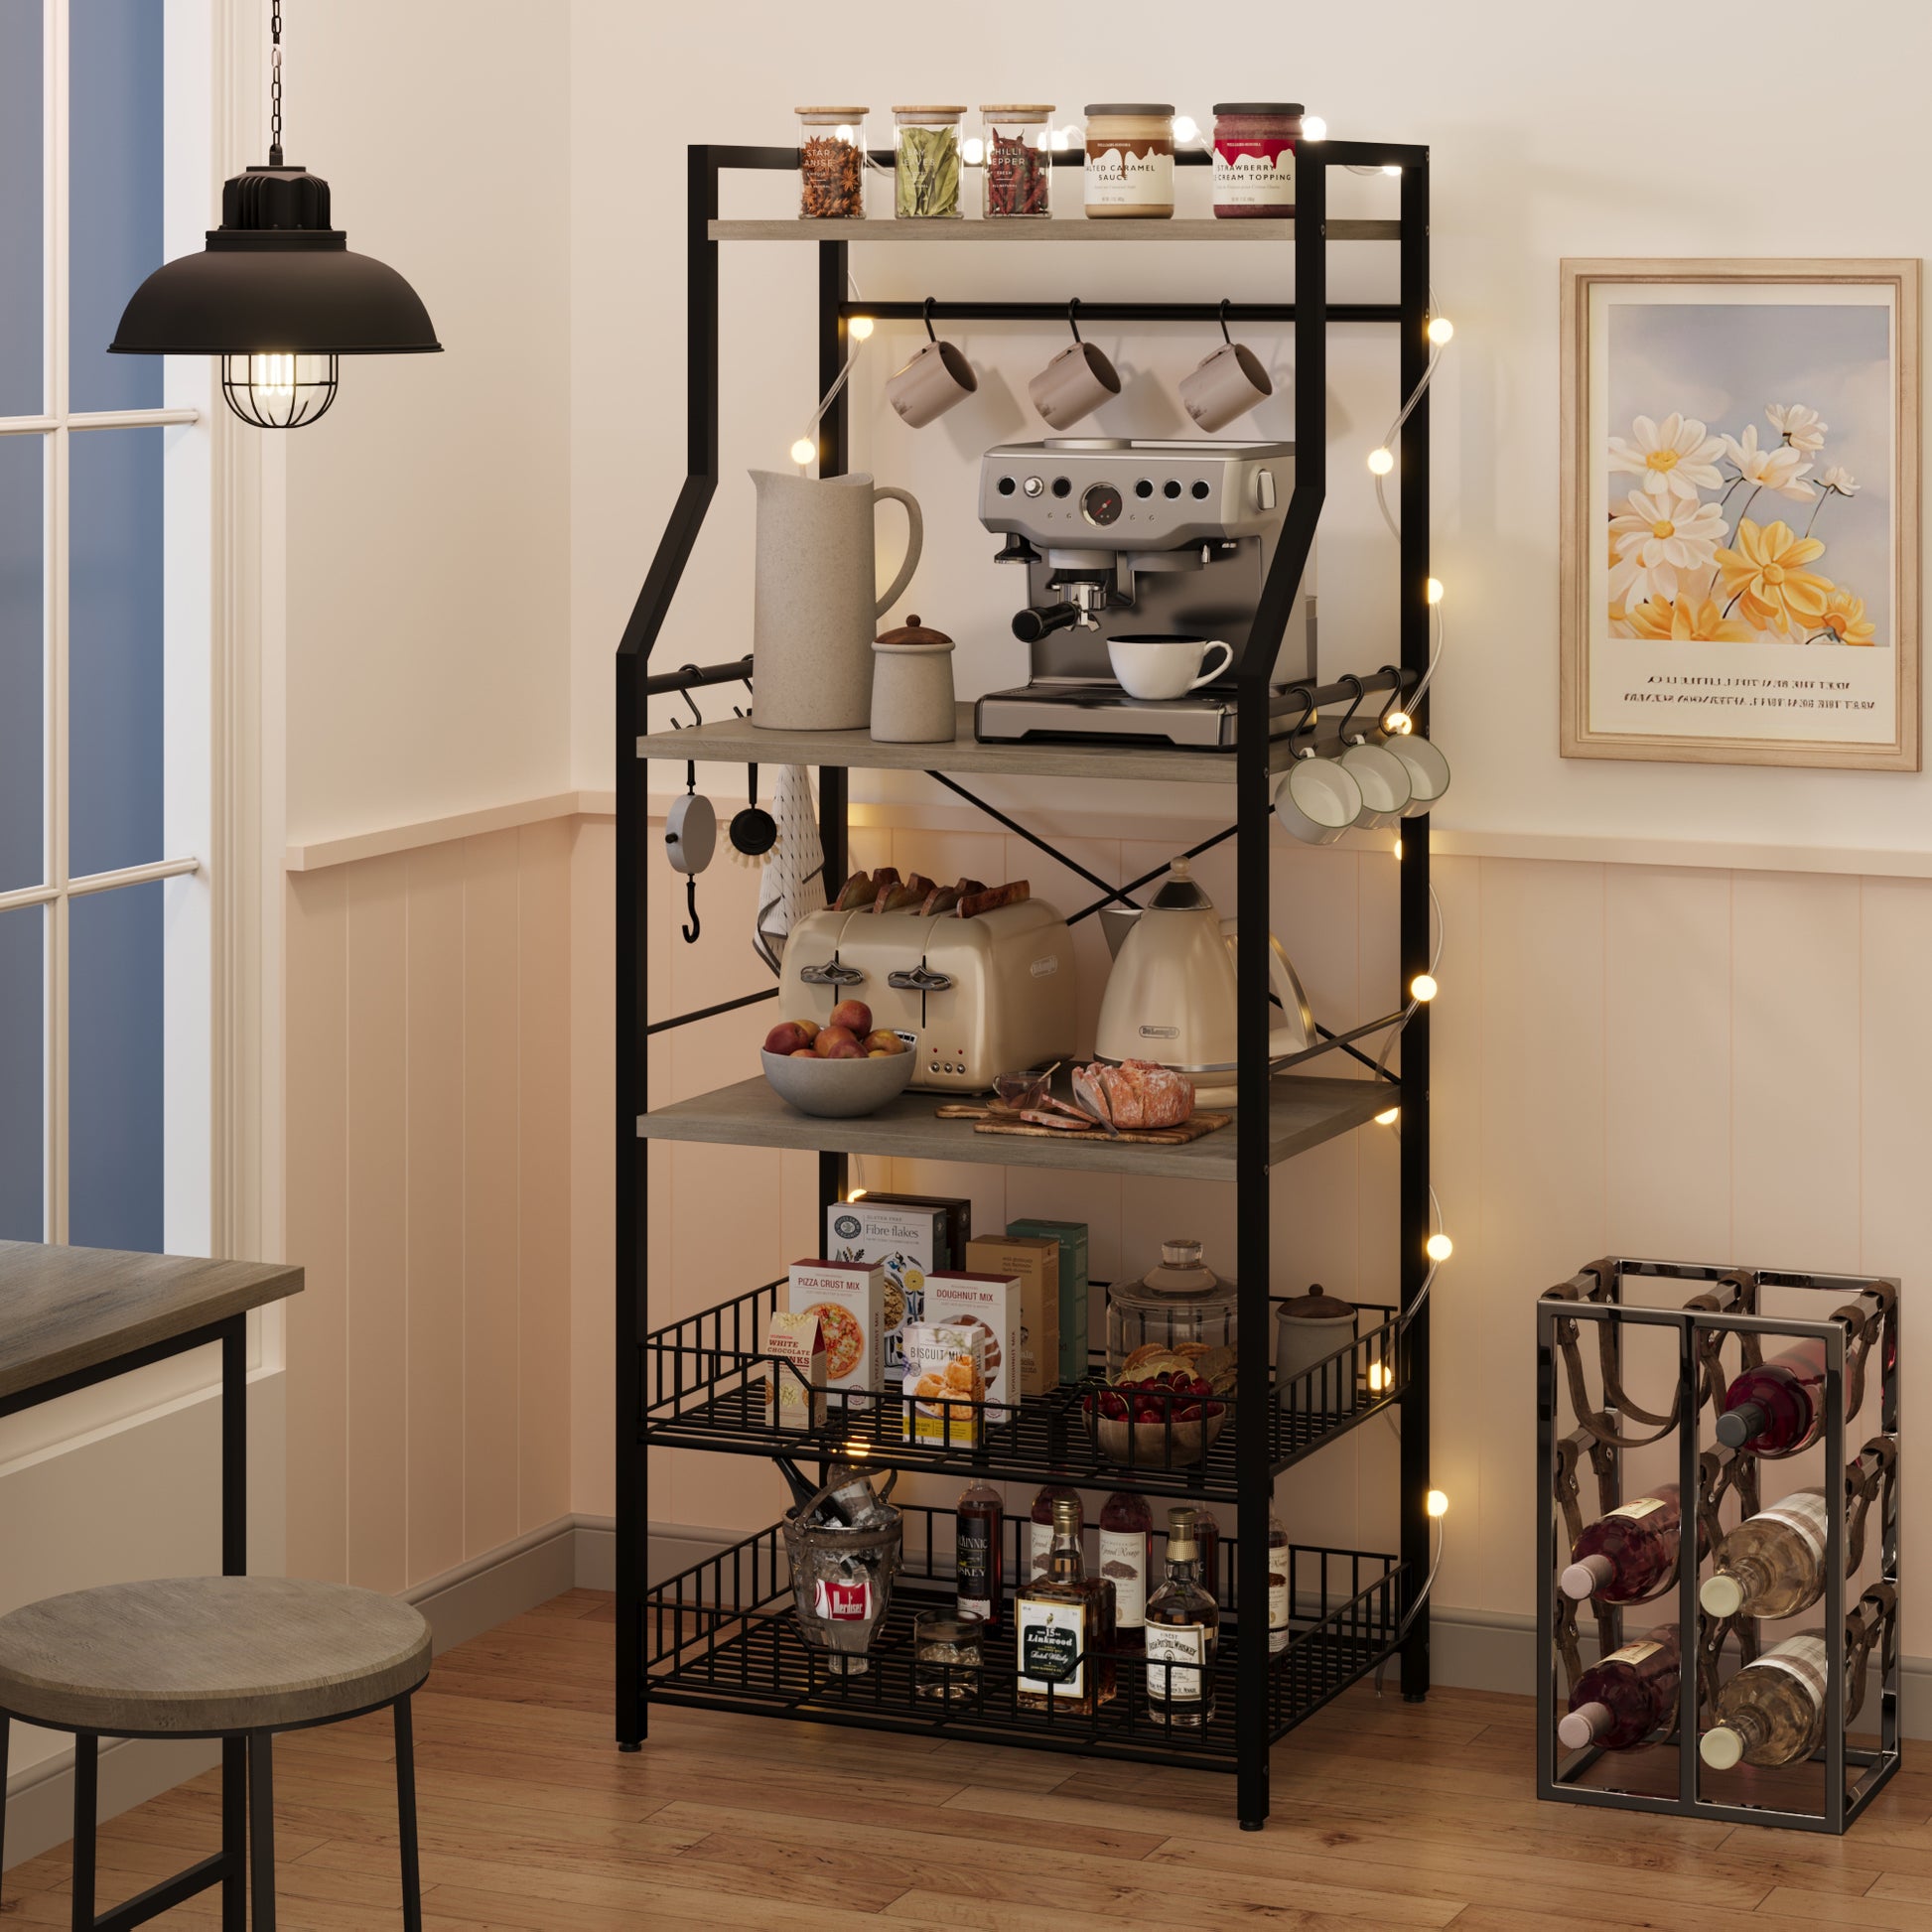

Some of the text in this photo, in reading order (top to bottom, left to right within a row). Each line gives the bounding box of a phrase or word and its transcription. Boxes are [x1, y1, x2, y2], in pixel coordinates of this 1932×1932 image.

[866, 1223, 919, 1239] Fibre flakes
[797, 1277, 861, 1291] PIZZA CRUST MIX
[936, 1289, 994, 1303] DOUGHNUT MIX
[768, 1338, 799, 1348] WHITE
[766, 1346, 811, 1356] CHOCOLATE
[909, 1346, 964, 1363] BISCUIT MIX
[1045, 1628, 1055, 1637] 15
[1027, 1633, 1073, 1647] Linkwood
[1174, 1639, 1198, 1657] WHISKEY
